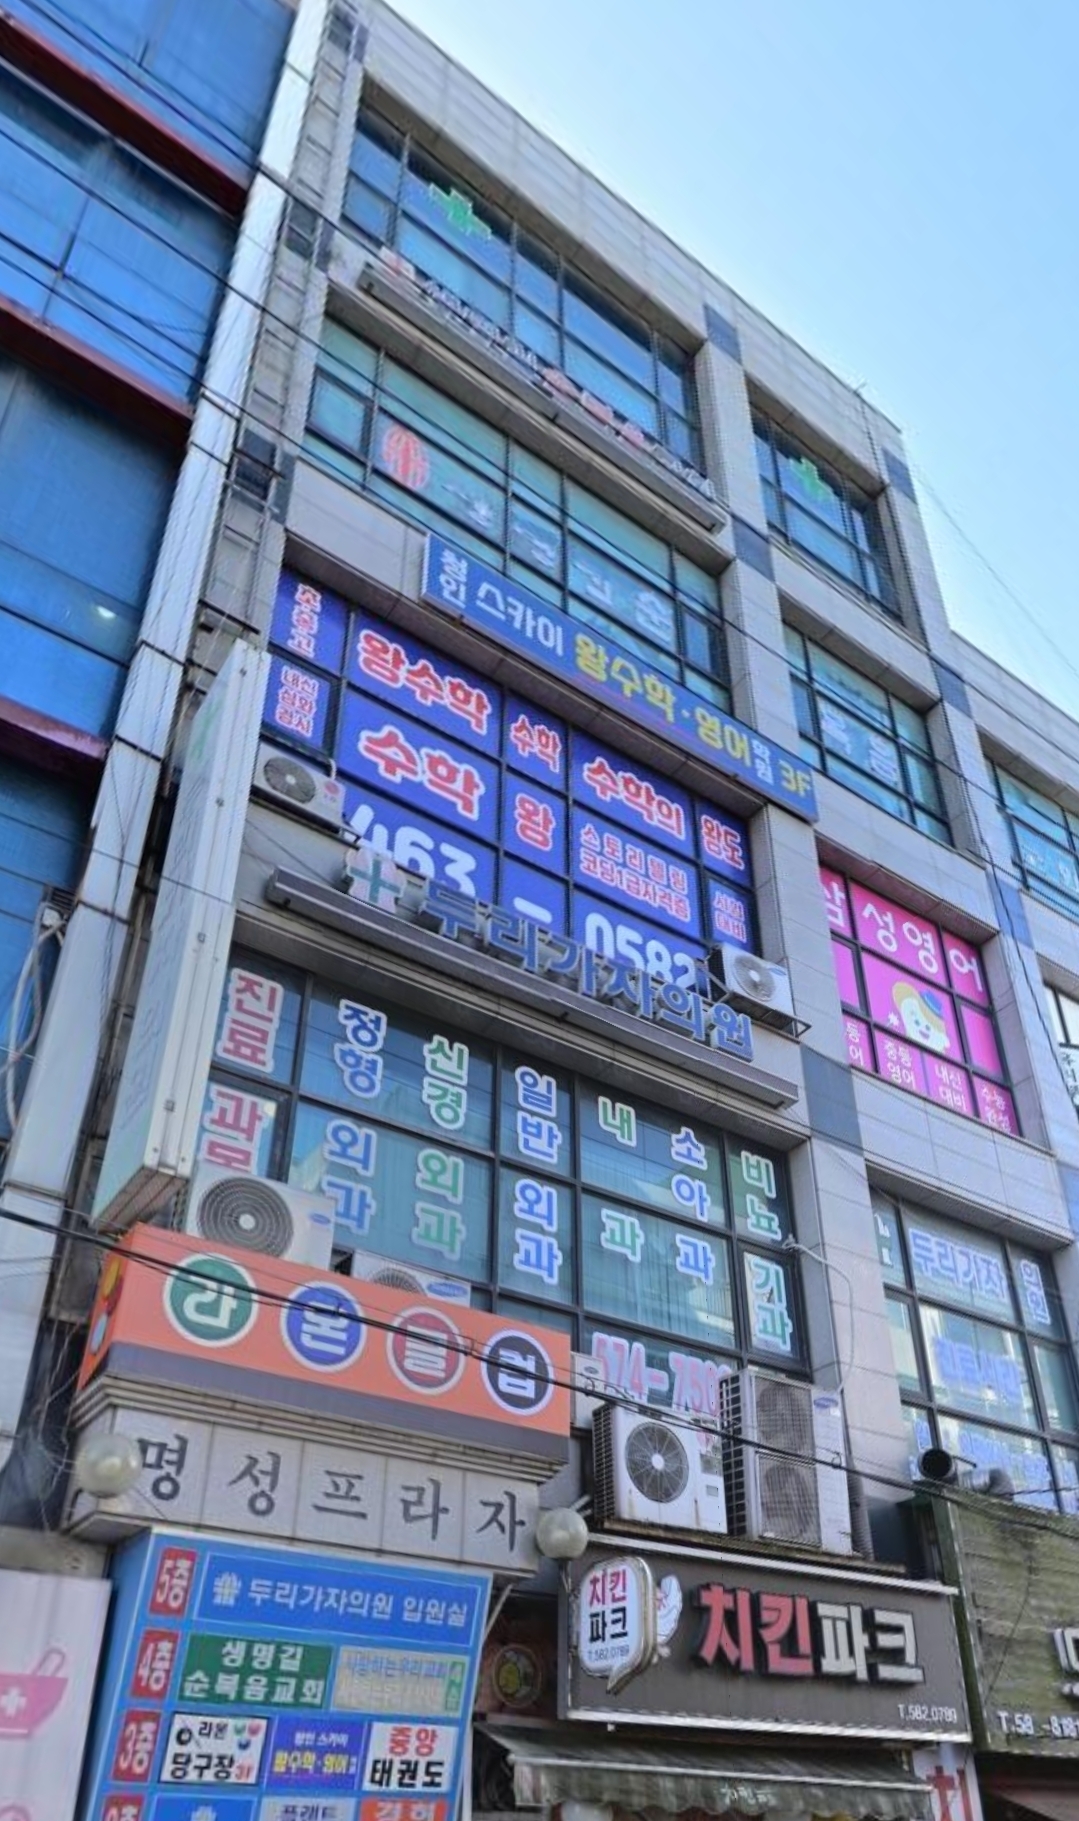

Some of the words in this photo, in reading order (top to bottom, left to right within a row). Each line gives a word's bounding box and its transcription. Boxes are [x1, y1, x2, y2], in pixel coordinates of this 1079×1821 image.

[357, 629, 492, 735] 왕수학
[475, 581, 564, 657] 스카이
[778, 757, 812, 798] 3F
[358, 724, 486, 822] 수학
[511, 713, 562, 774] 수학
[514, 793, 557, 851] 왕
[583, 756, 686, 841] 수학의
[420, 876, 754, 1063] 두리가자의원
[216, 967, 284, 1073] 진료
[322, 999, 388, 1235] 정형외과
[514, 1065, 562, 1286] 일반외과
[670, 1126, 716, 1286] 소아과
[908, 1227, 1008, 1303] 두리가자
[136, 1433, 527, 1553] 명성프라자
[156, 1558, 193, 1610] 5층
[248, 1577, 393, 1620] 두리가자의원
[403, 1596, 468, 1628] 입원실
[589, 1569, 627, 1607] 치킨
[589, 1606, 628, 1643] 파크
[699, 1581, 926, 1684] 치킨파크
[138, 1638, 174, 1692] 4층
[221, 1640, 304, 1673] 생명길
[183, 1669, 325, 1706] 순복음교회
[119, 1721, 157, 1775] 3층
[198, 1721, 229, 1741] 라온
[389, 1726, 438, 1757] 중앙
[170, 1752, 235, 1781] 당구장
[370, 1758, 444, 1788] 태권도
